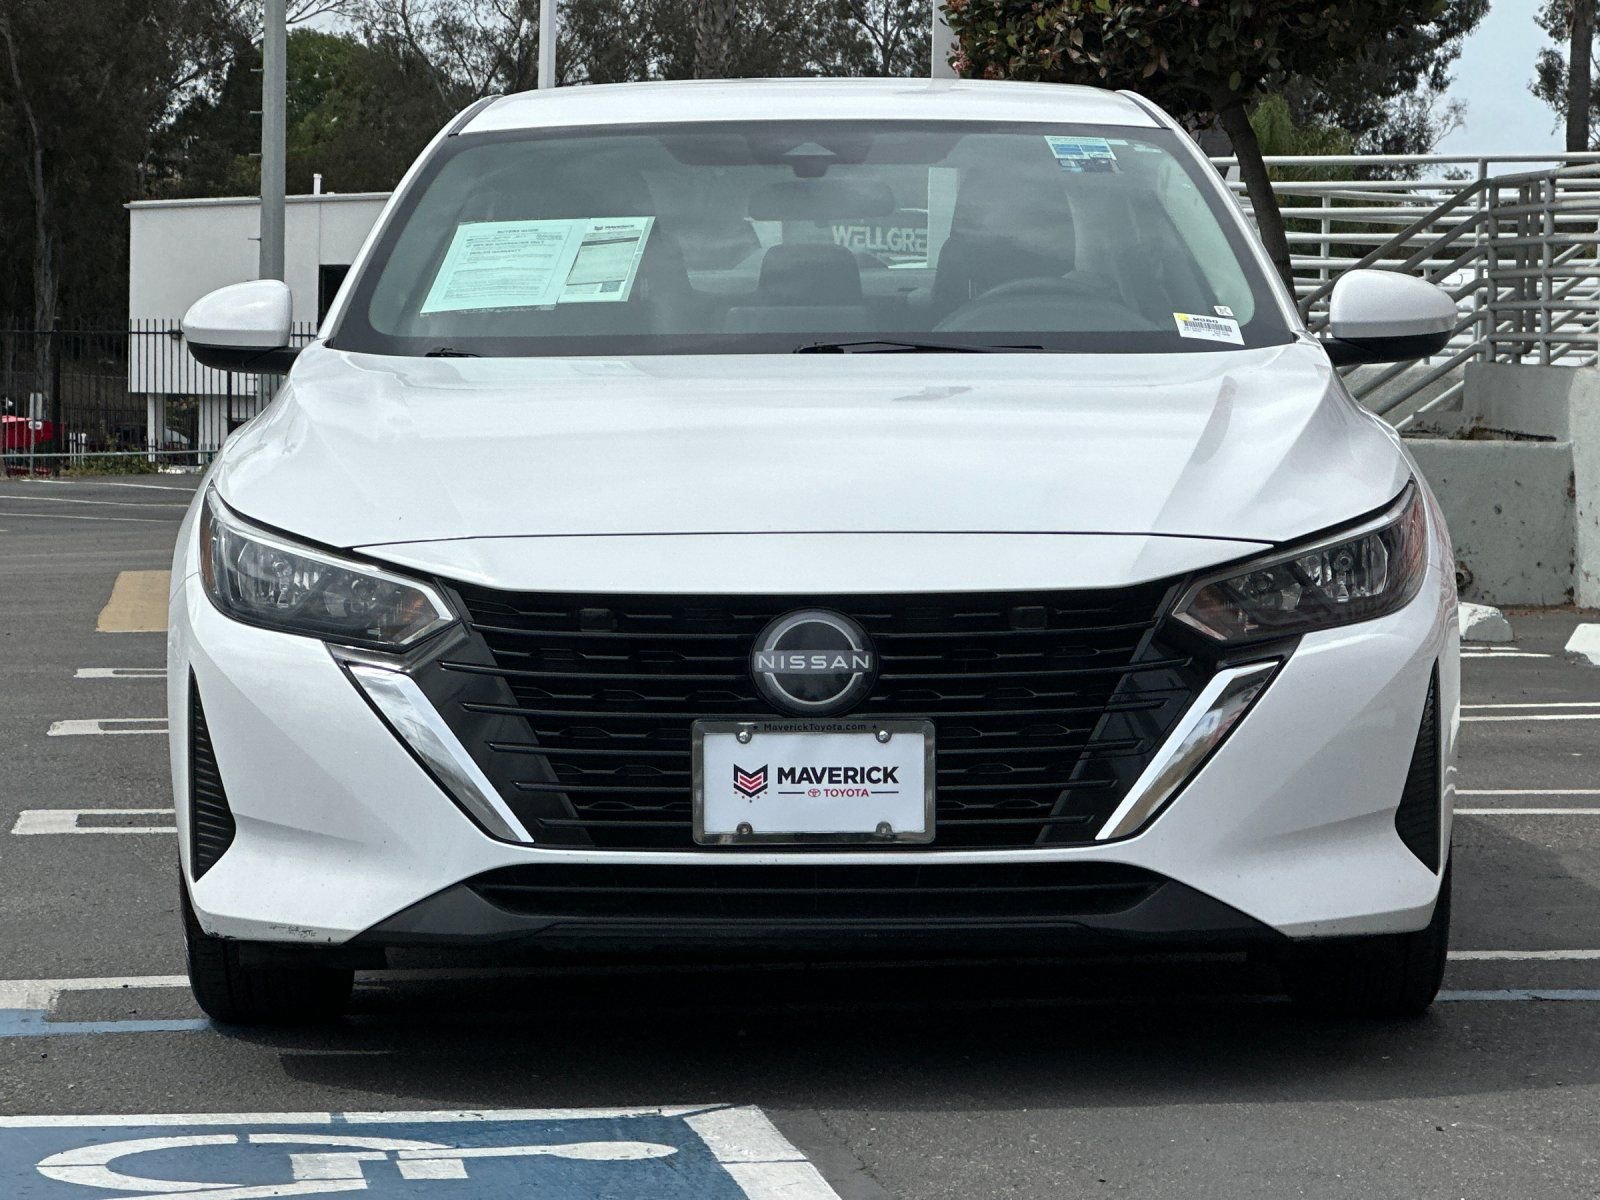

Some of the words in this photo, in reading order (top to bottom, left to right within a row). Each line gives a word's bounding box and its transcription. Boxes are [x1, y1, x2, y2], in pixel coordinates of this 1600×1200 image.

[832, 224, 927, 252] WELLGRE
[758, 655, 870, 669] NISSAN
[763, 722, 867, 732] MaverickToyota.com
[777, 766, 900, 785] MAVERICK
[823, 788, 869, 798] TOYOTA
